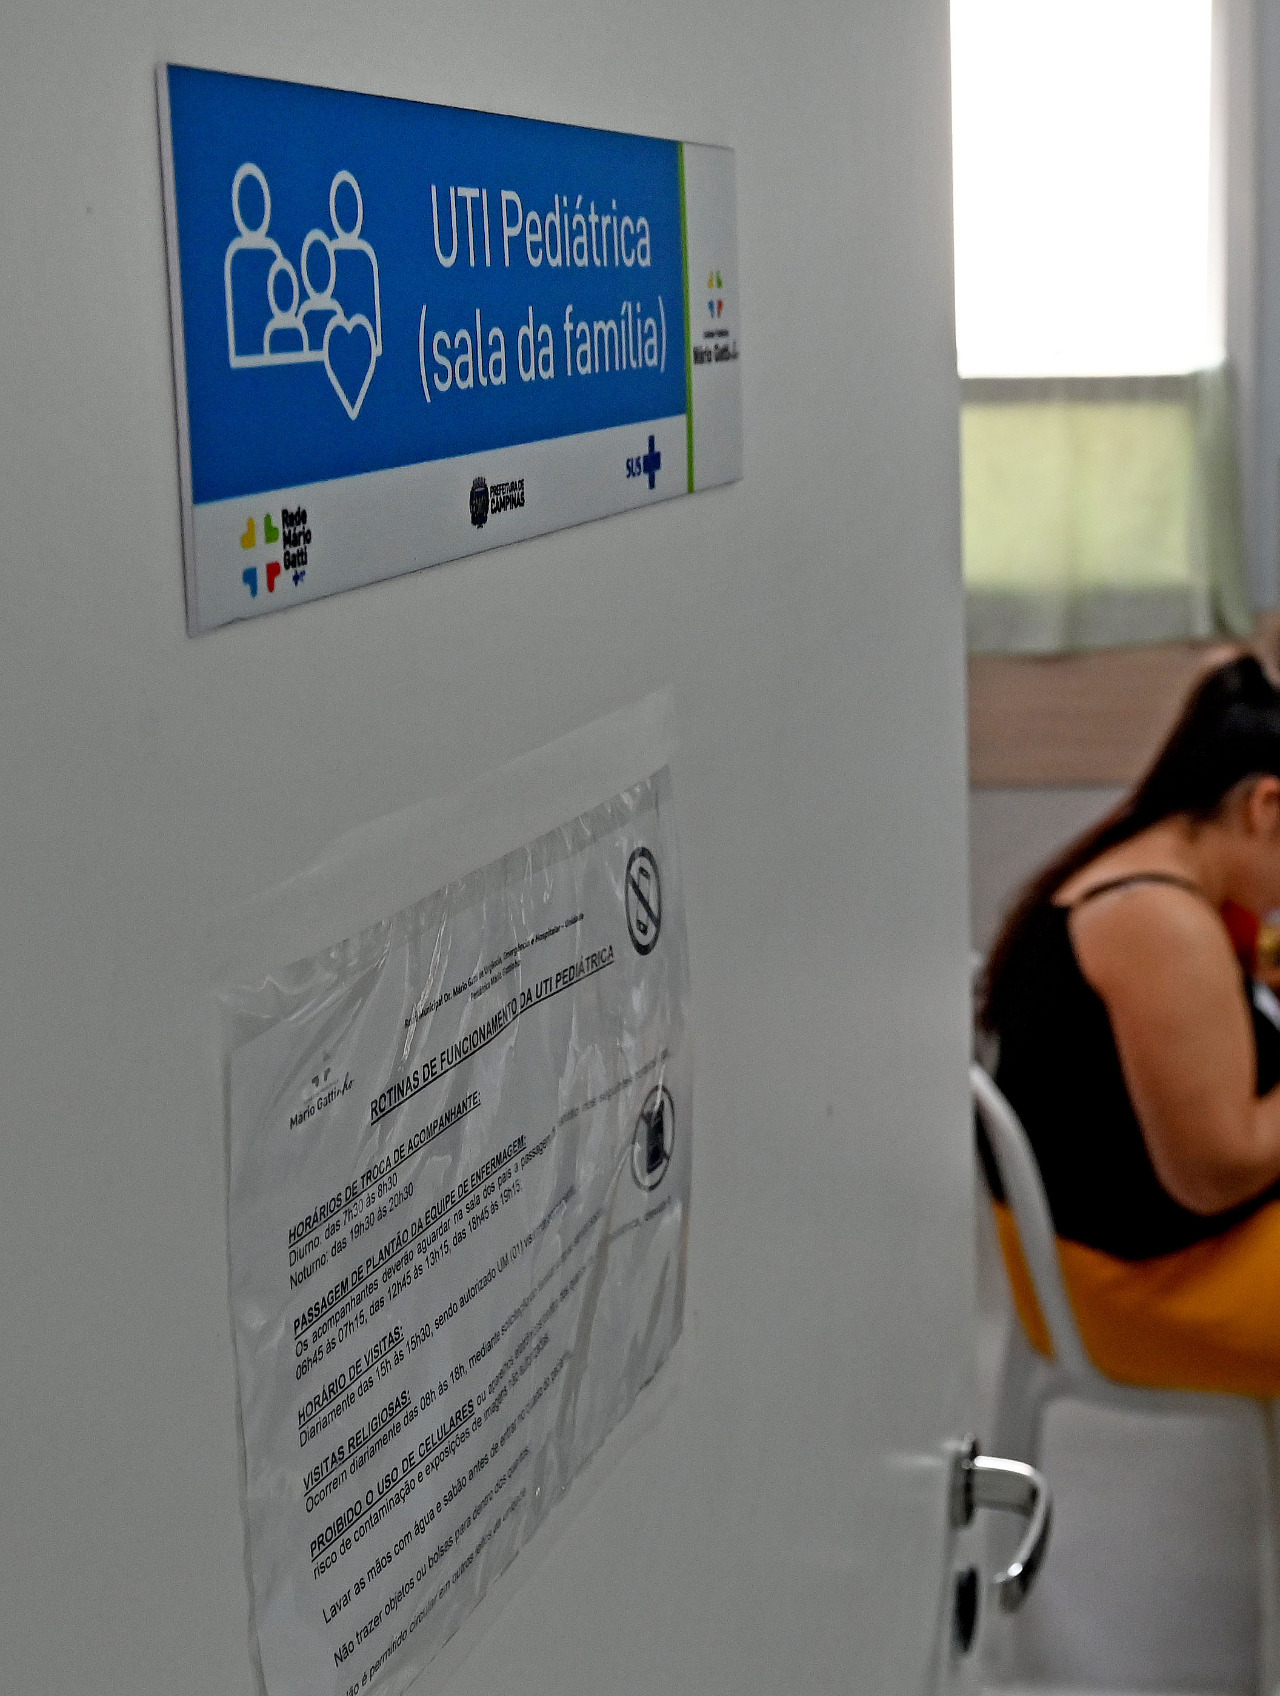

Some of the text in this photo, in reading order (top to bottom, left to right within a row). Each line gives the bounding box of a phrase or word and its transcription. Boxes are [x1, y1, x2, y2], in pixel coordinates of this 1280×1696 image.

[431, 183, 651, 268] UTI Pediátrica
[418, 295, 667, 403] (sala da família)
[281, 506, 307, 529] Rede
[490, 491, 525, 514] CAMPINAS
[626, 455, 642, 478] SUS
[283, 525, 312, 549] Mário
[283, 546, 308, 570] Gatti
[370, 1072, 420, 1121] ROTINAS
[422, 1058, 437, 1083] DE
[440, 999, 518, 1071] FUNCIONAMENTO
[520, 988, 533, 1009] DA
[535, 978, 554, 999] UTI
[554, 945, 615, 989] PEDIÁTRICA
[287, 1091, 482, 1244] HORÁRIOS DE TROCA DE ACOMPANHANTE:
[324, 1218, 342, 1240] das
[342, 1198, 365, 1226] 7h30
[377, 1172, 398, 1197] 8h30
[289, 1183, 414, 1290] Noturno: das 19h30 às 20h30
[294, 1134, 527, 1335] PASSAGEM DE PLANTÃO DA EQUIPE DE ENFERMAGEM:
[295, 1338, 309, 1357] Os
[312, 1281, 379, 1345] acompanhantes
[382, 1250, 415, 1284] deverão
[416, 1219, 452, 1256] aguardar
[452, 1206, 465, 1224] na
[465, 1193, 482, 1214] sala
[482, 1179, 497, 1200] dos
[497, 1167, 512, 1190] pais
[295, 1348, 324, 1381] 06h45
[325, 1338, 337, 1357] às
[337, 1311, 368, 1344] 07h15,
[369, 1297, 385, 1317] das
[387, 1272, 413, 1302] 12h45
[412, 1264, 424, 1282] às
[424, 1242, 453, 1272] 13h15,
[452, 1228, 467, 1246] das
[467, 1203, 490, 1233] 18h45
[490, 1197, 500, 1214] às
[298, 1324, 405, 1426] HORÁRIO DE VISITAS:
[299, 1392, 356, 1448] Diariamente
[357, 1377, 374, 1398] das
[375, 1356, 392, 1376] 15h
[393, 1346, 405, 1365] às
[405, 1325, 434, 1356] 15h30,
[434, 1303, 459, 1330] sendo
[459, 1269, 497, 1308] autorizado
[302, 1390, 412, 1490] VISITAS RELIGIOSAS:
[305, 1329, 501, 1513] Ocorrem diariamente das 08h às 18h, mediante
[310, 1500, 362, 1558] PROIBIDO
[365, 1490, 374, 1506] O
[377, 1466, 399, 1498] USO
[401, 1450, 415, 1473] DE
[417, 1398, 475, 1459] CELULARES
[476, 1390, 487, 1407] ou
[313, 1552, 337, 1580] risco
[339, 1536, 352, 1557] de
[353, 1478, 416, 1542] contaminação
[417, 1471, 424, 1483] e
[424, 1429, 471, 1476] exposições
[471, 1416, 483, 1433] de
[322, 1588, 352, 1625] Lavar
[353, 1577, 367, 1596] as
[367, 1551, 393, 1583] mãos
[393, 1532, 414, 1556] com
[414, 1511, 436, 1538] água
[436, 1501, 443, 1514] e
[443, 1477, 468, 1507] sabão
[468, 1453, 490, 1481] antes
[490, 1441, 500, 1458] de
[333, 1642, 355, 1668] Não
[355, 1610, 383, 1646] trazer
[384, 1577, 416, 1618] objetos
[416, 1565, 428, 1583] ou
[428, 1538, 454, 1568] bolsas
[454, 1516, 472, 1545] para
[361, 1670, 369, 1688] é
